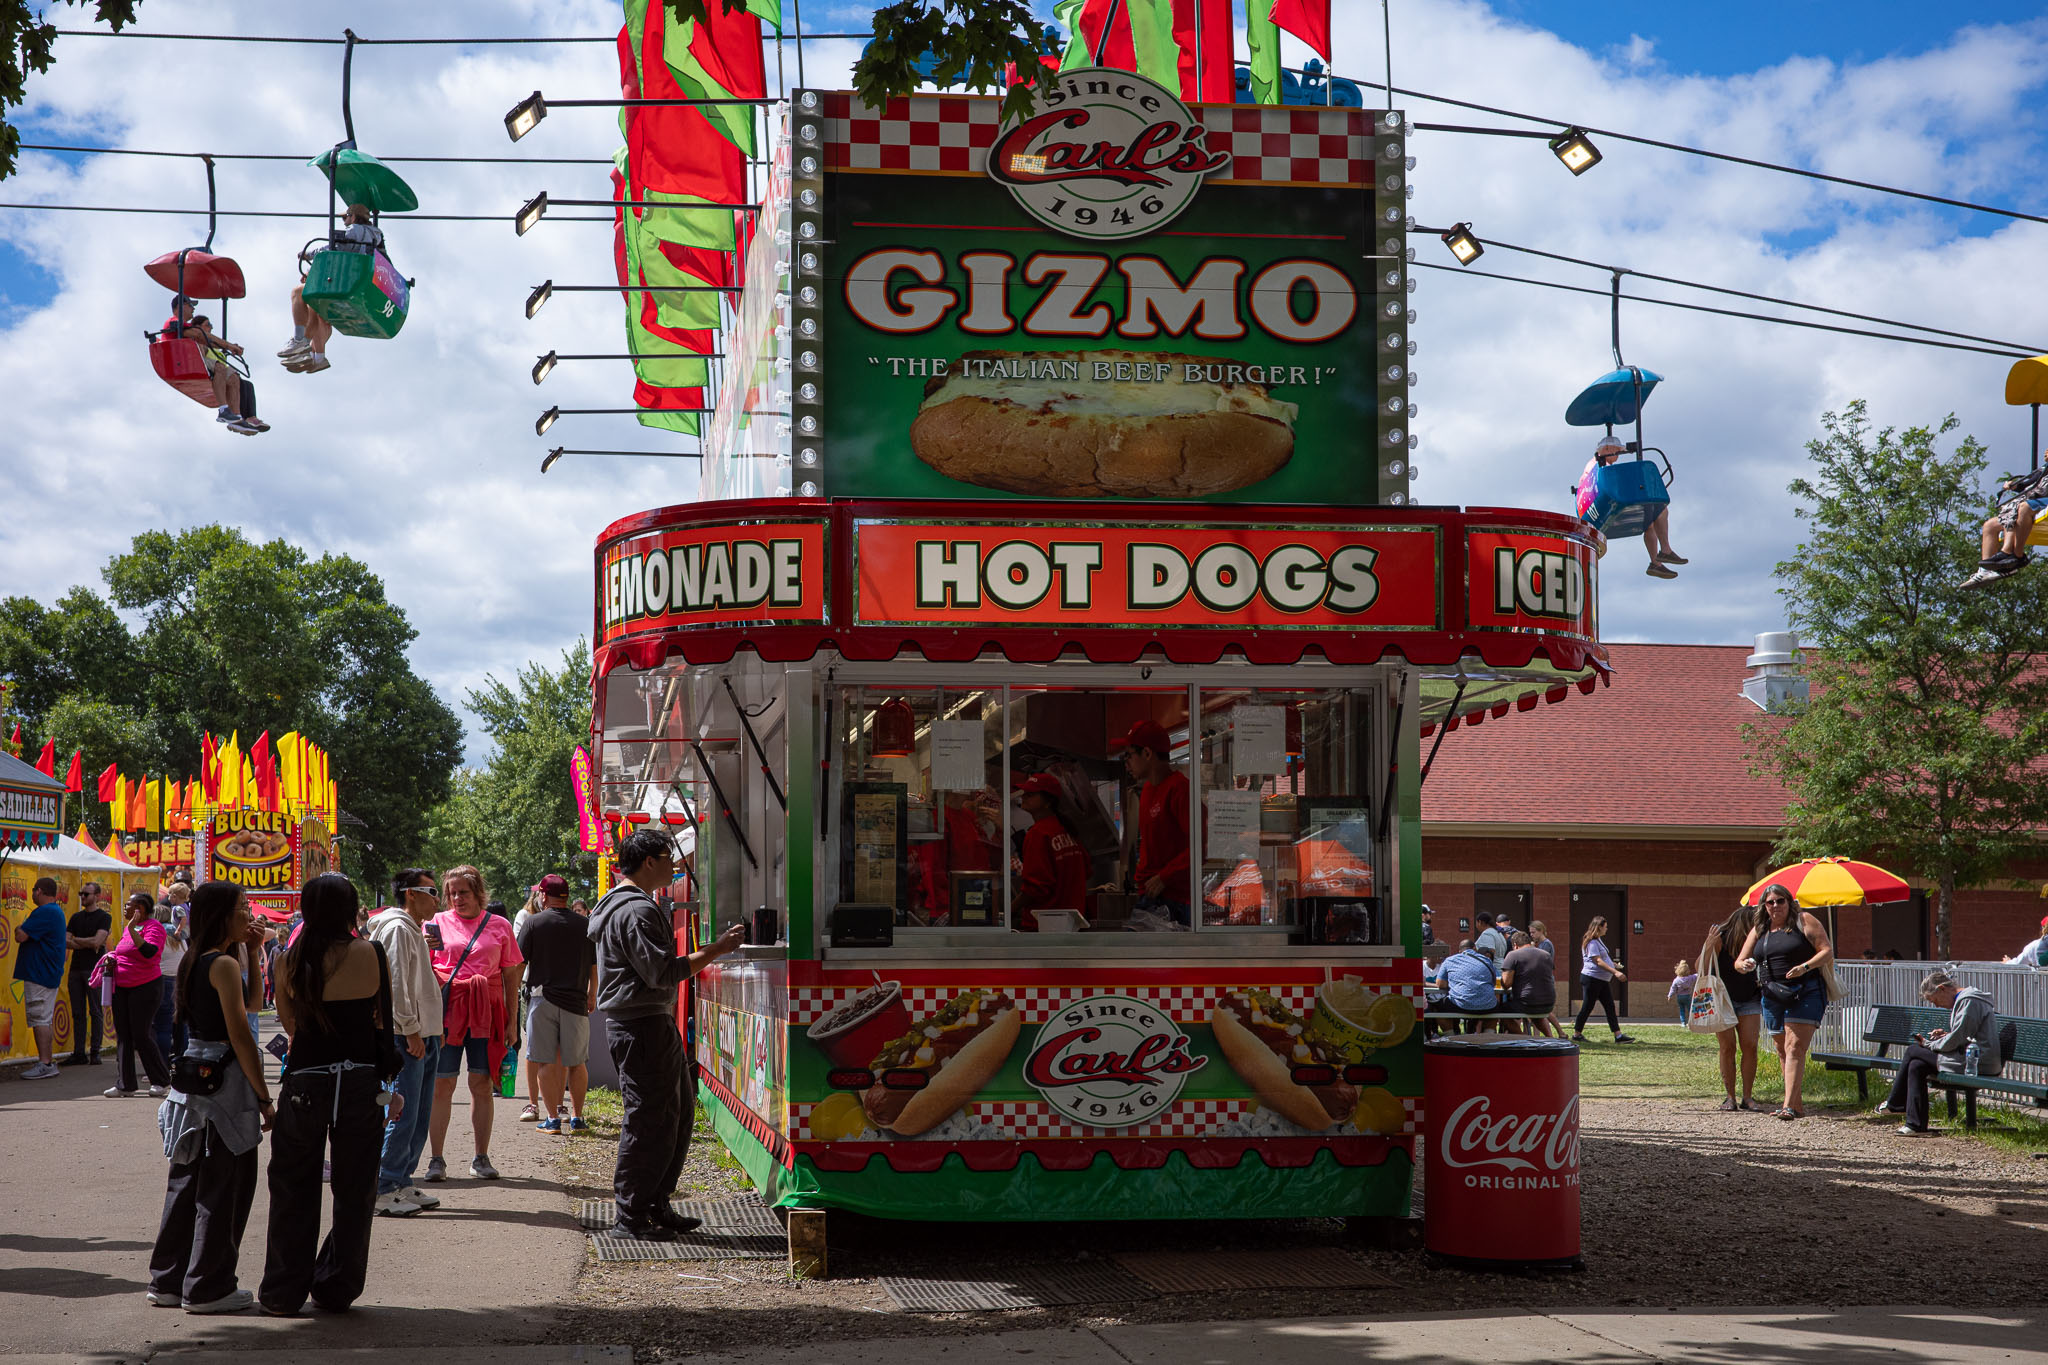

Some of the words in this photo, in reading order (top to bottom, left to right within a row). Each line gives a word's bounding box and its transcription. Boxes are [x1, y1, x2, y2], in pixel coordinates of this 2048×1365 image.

[1045, 79, 1161, 113] Since
[989, 108, 1229, 189] Carl's
[1044, 194, 1164, 225] 1946
[846, 247, 1358, 342] GIZMO
[962, 358, 1080, 380] ITALIAN
[1092, 360, 1173, 383] BEEF
[603, 540, 803, 618] LEMONADE
[916, 540, 1103, 610] HOT
[1127, 542, 1381, 615] DOGS
[1494, 548, 1584, 619] ICED
[214, 811, 295, 836] BUCKET
[123, 839, 196, 865] CHEE
[215, 861, 292, 887] DONUTS
[1518, 894, 1524, 902] 7
[1573, 894, 1579, 902] 8
[1064, 1004, 1155, 1028] Since
[1025, 1027, 1207, 1088] Carl's
[1066, 1091, 1159, 1117] 1946
[1464, 1174, 1560, 1189] ORIGINAL
